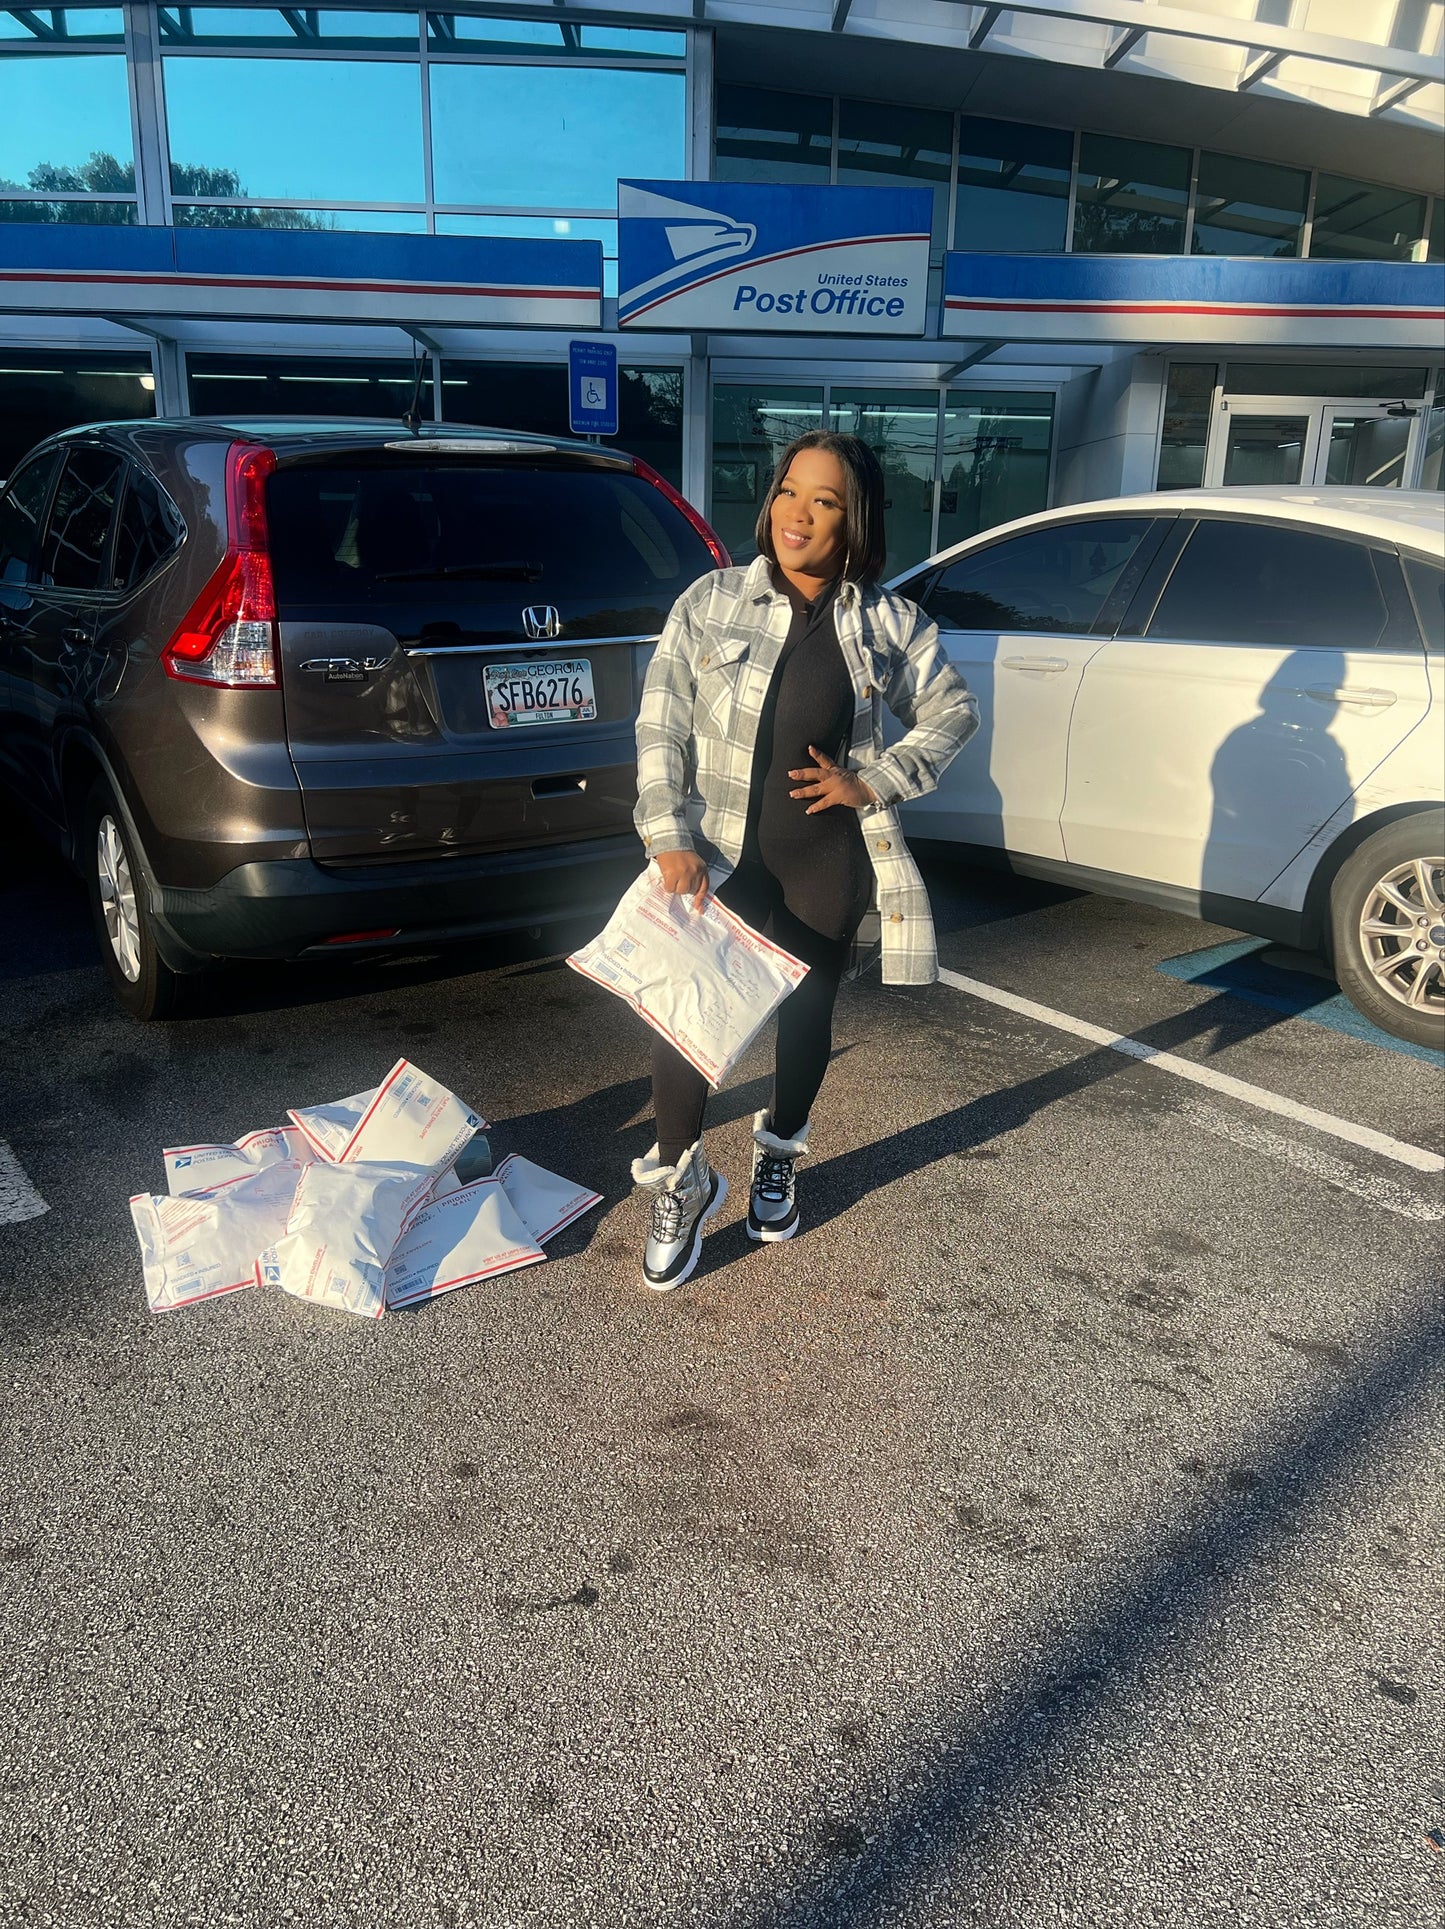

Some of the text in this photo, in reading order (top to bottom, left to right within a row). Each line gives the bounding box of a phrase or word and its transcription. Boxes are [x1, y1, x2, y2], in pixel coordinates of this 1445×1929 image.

[818, 273, 908, 287] United States
[733, 285, 905, 317] Post Office
[328, 673, 364, 681] AutoNation
[527, 662, 584, 677] GEORGIA
[495, 677, 583, 712] SFB6276
[535, 711, 554, 719] FULTON
[732, 925, 763, 952] PRIORITY
[734, 936, 751, 952] MAIL
[442, 1191, 476, 1206] PRIORITY
[453, 1198, 471, 1207] MAIL
[416, 1262, 439, 1274] INSURED
